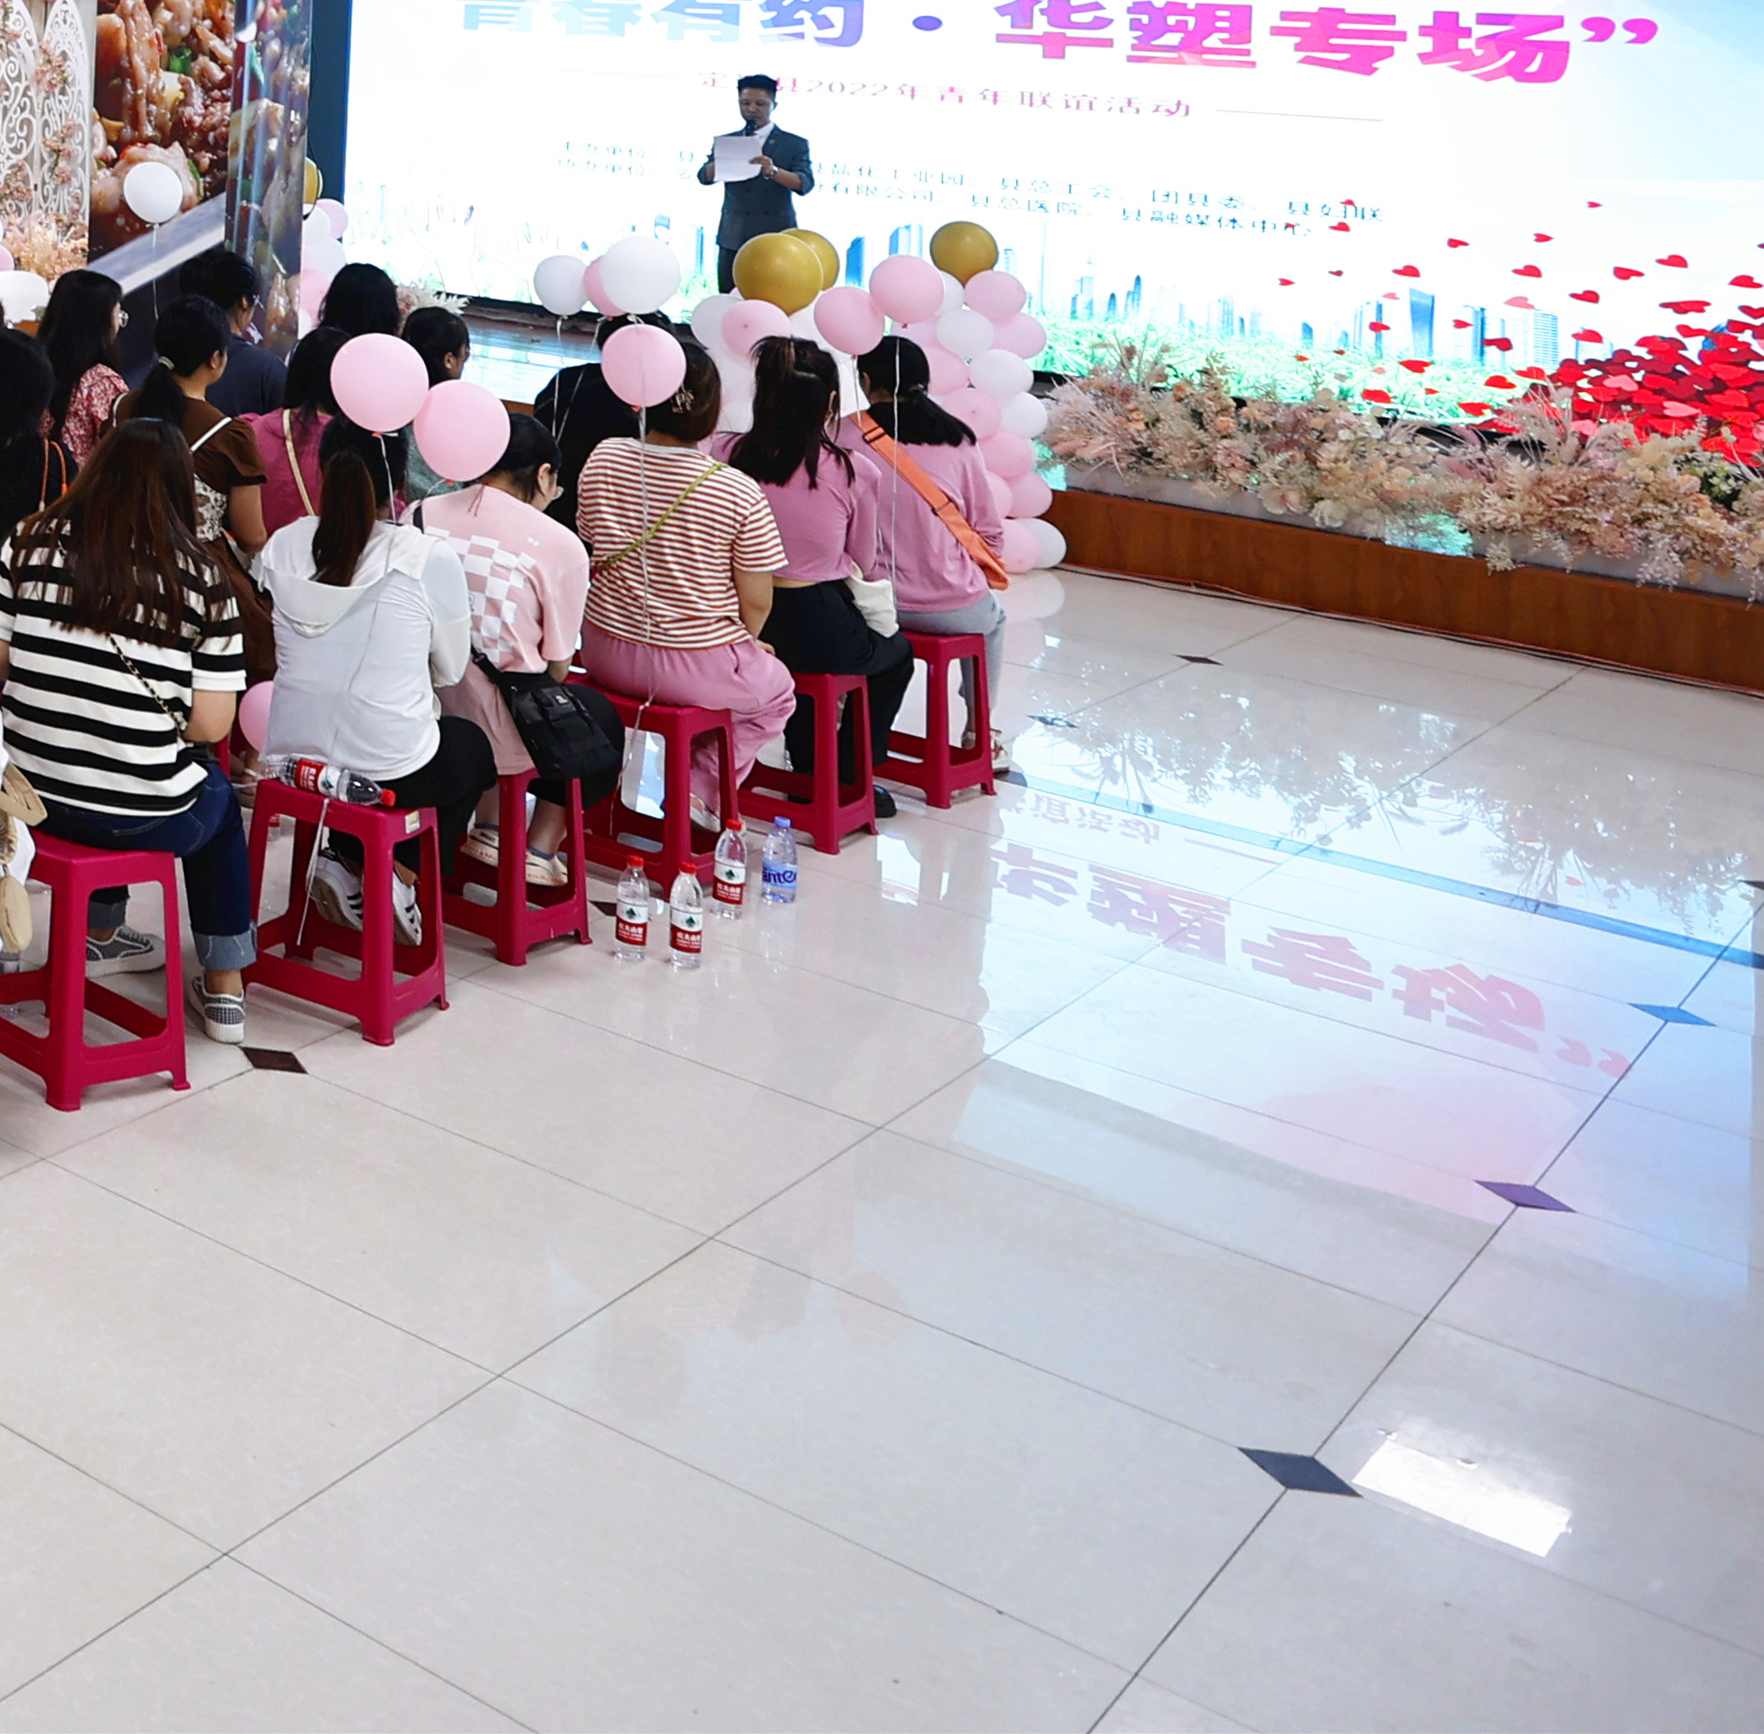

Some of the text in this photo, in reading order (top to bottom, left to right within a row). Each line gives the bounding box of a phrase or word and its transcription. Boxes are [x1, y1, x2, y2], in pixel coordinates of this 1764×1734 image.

[699, 70, 1191, 118] 定县2022年青年联谊活动
[762, 869, 797, 884] ante
